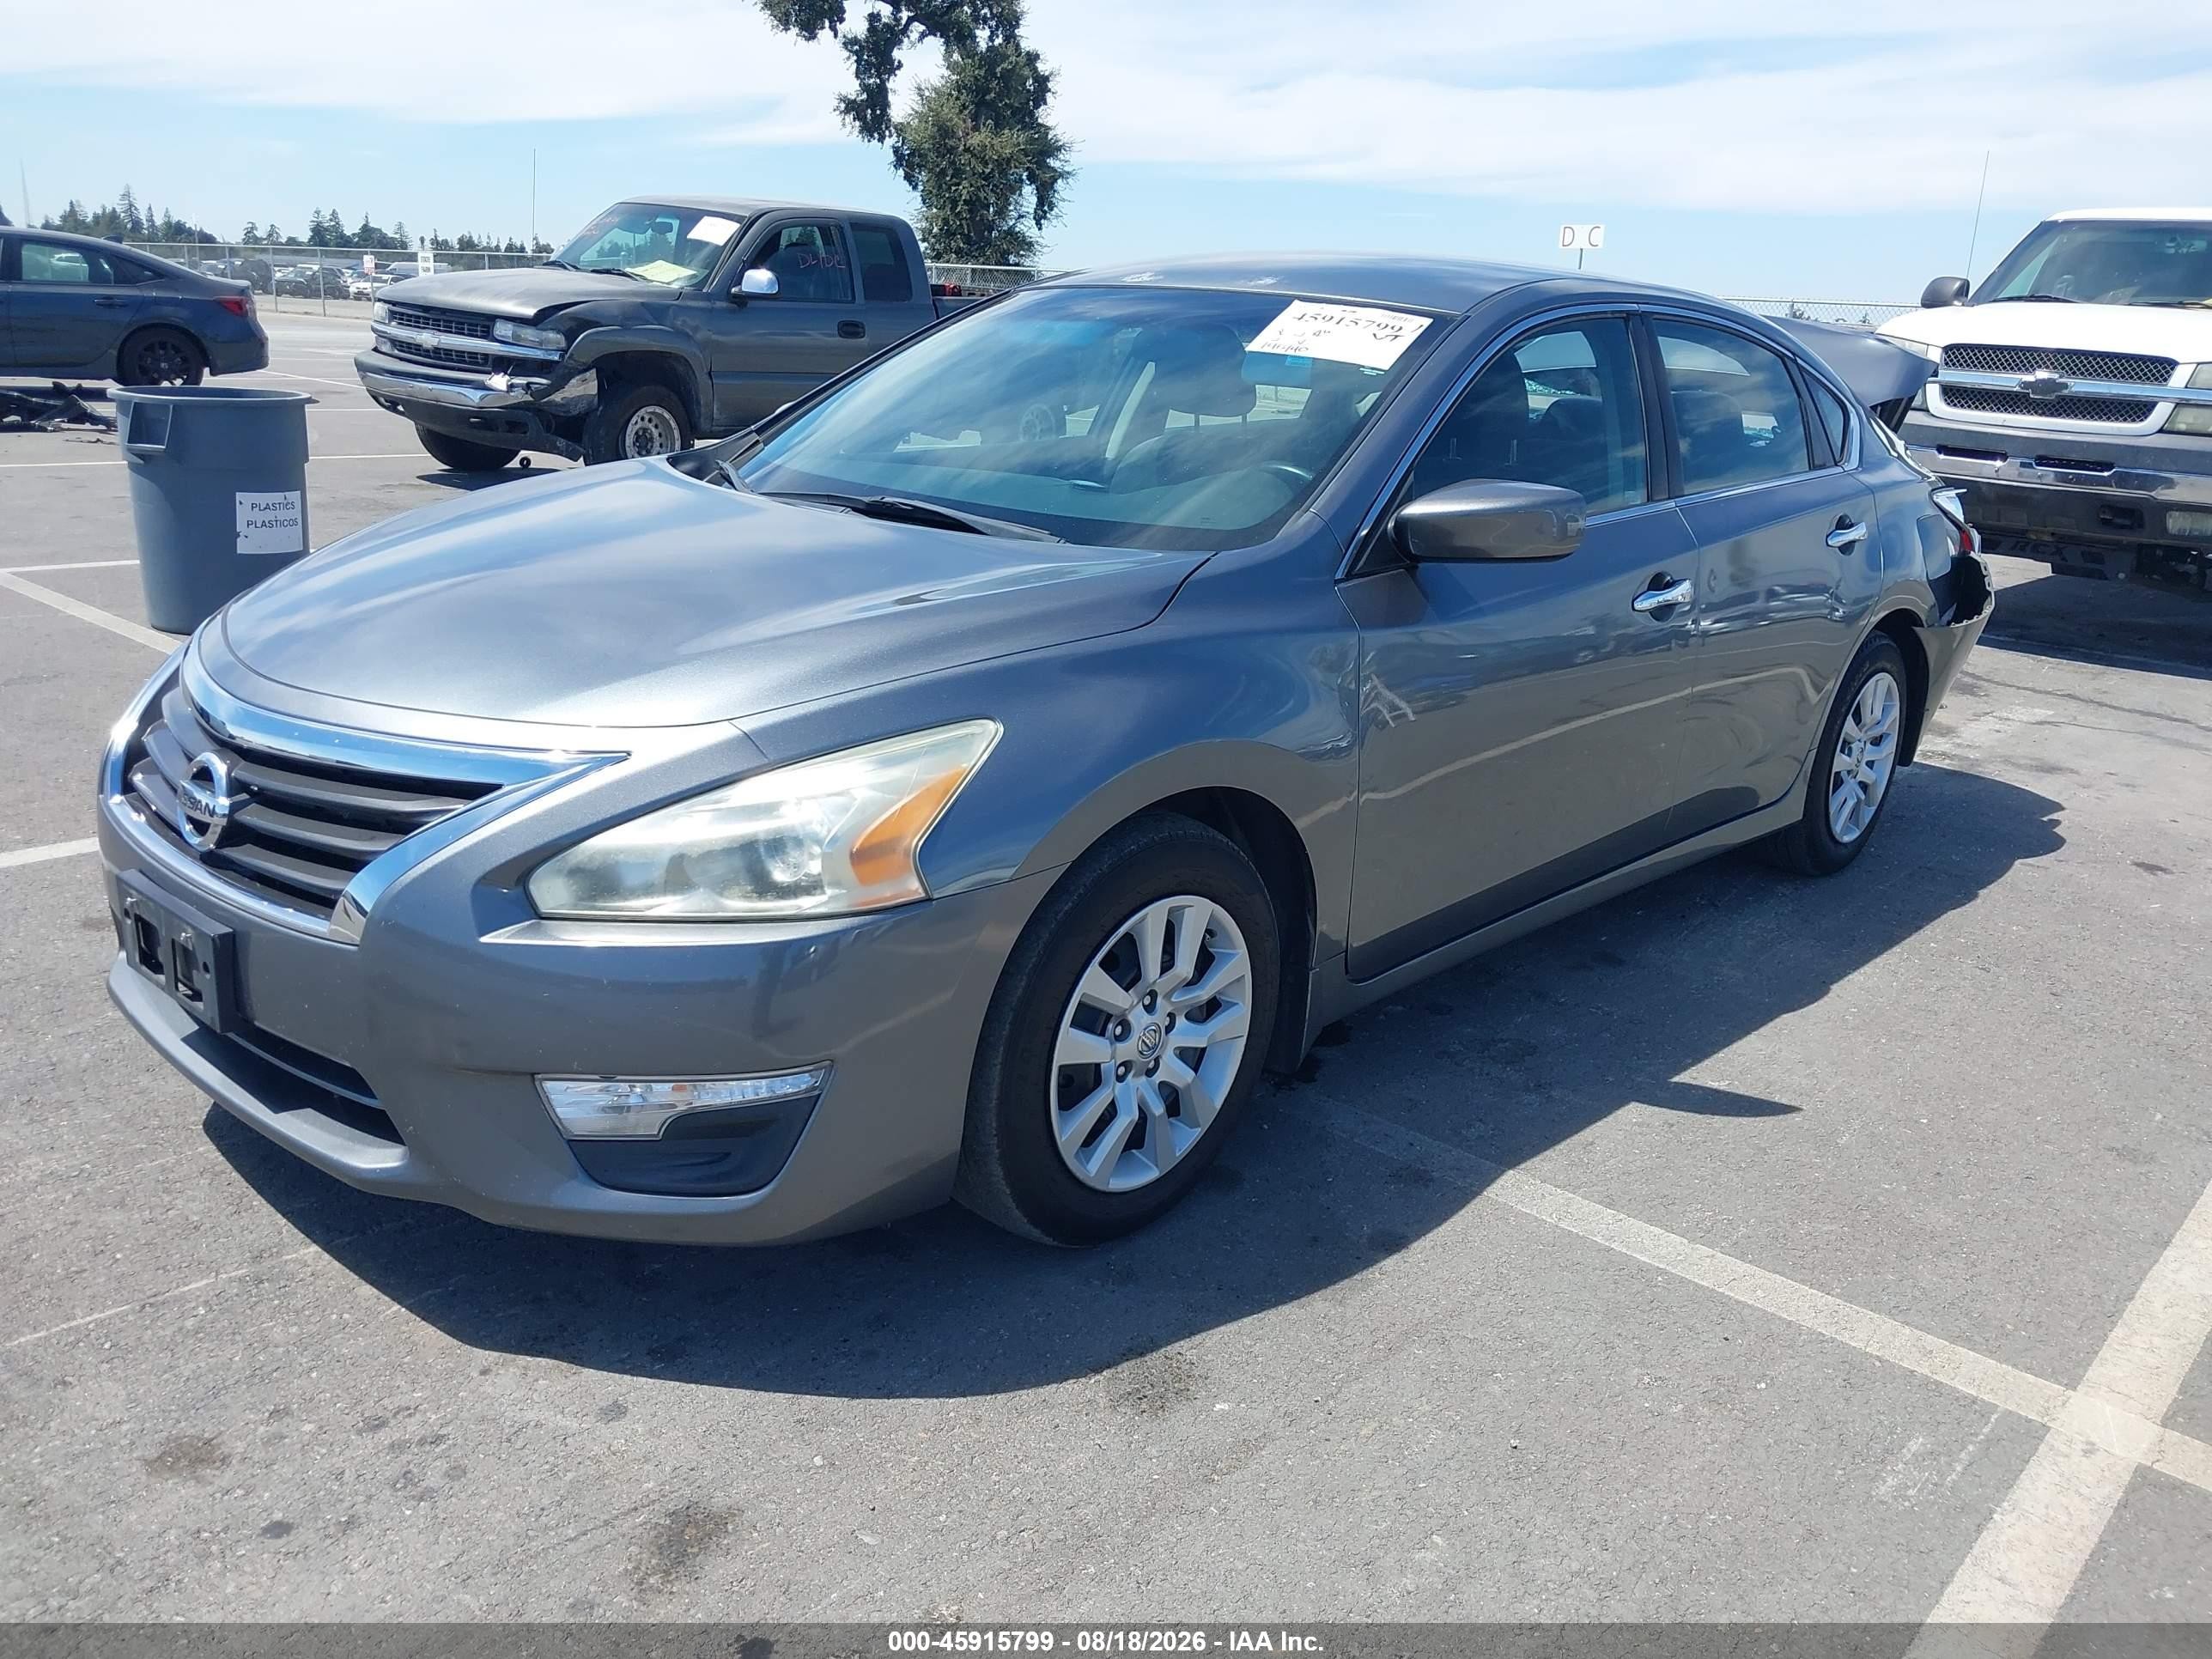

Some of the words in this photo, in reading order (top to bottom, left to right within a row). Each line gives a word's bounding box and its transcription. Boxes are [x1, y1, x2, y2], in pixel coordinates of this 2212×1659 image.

[1562, 226, 1575, 247] D
[1588, 226, 1601, 247] C
[1292, 312, 1404, 333] 45915799
[251, 501, 295, 512] PLASTICS
[246, 518, 299, 529] PLASTICOS
[180, 791, 216, 818] SSAN
